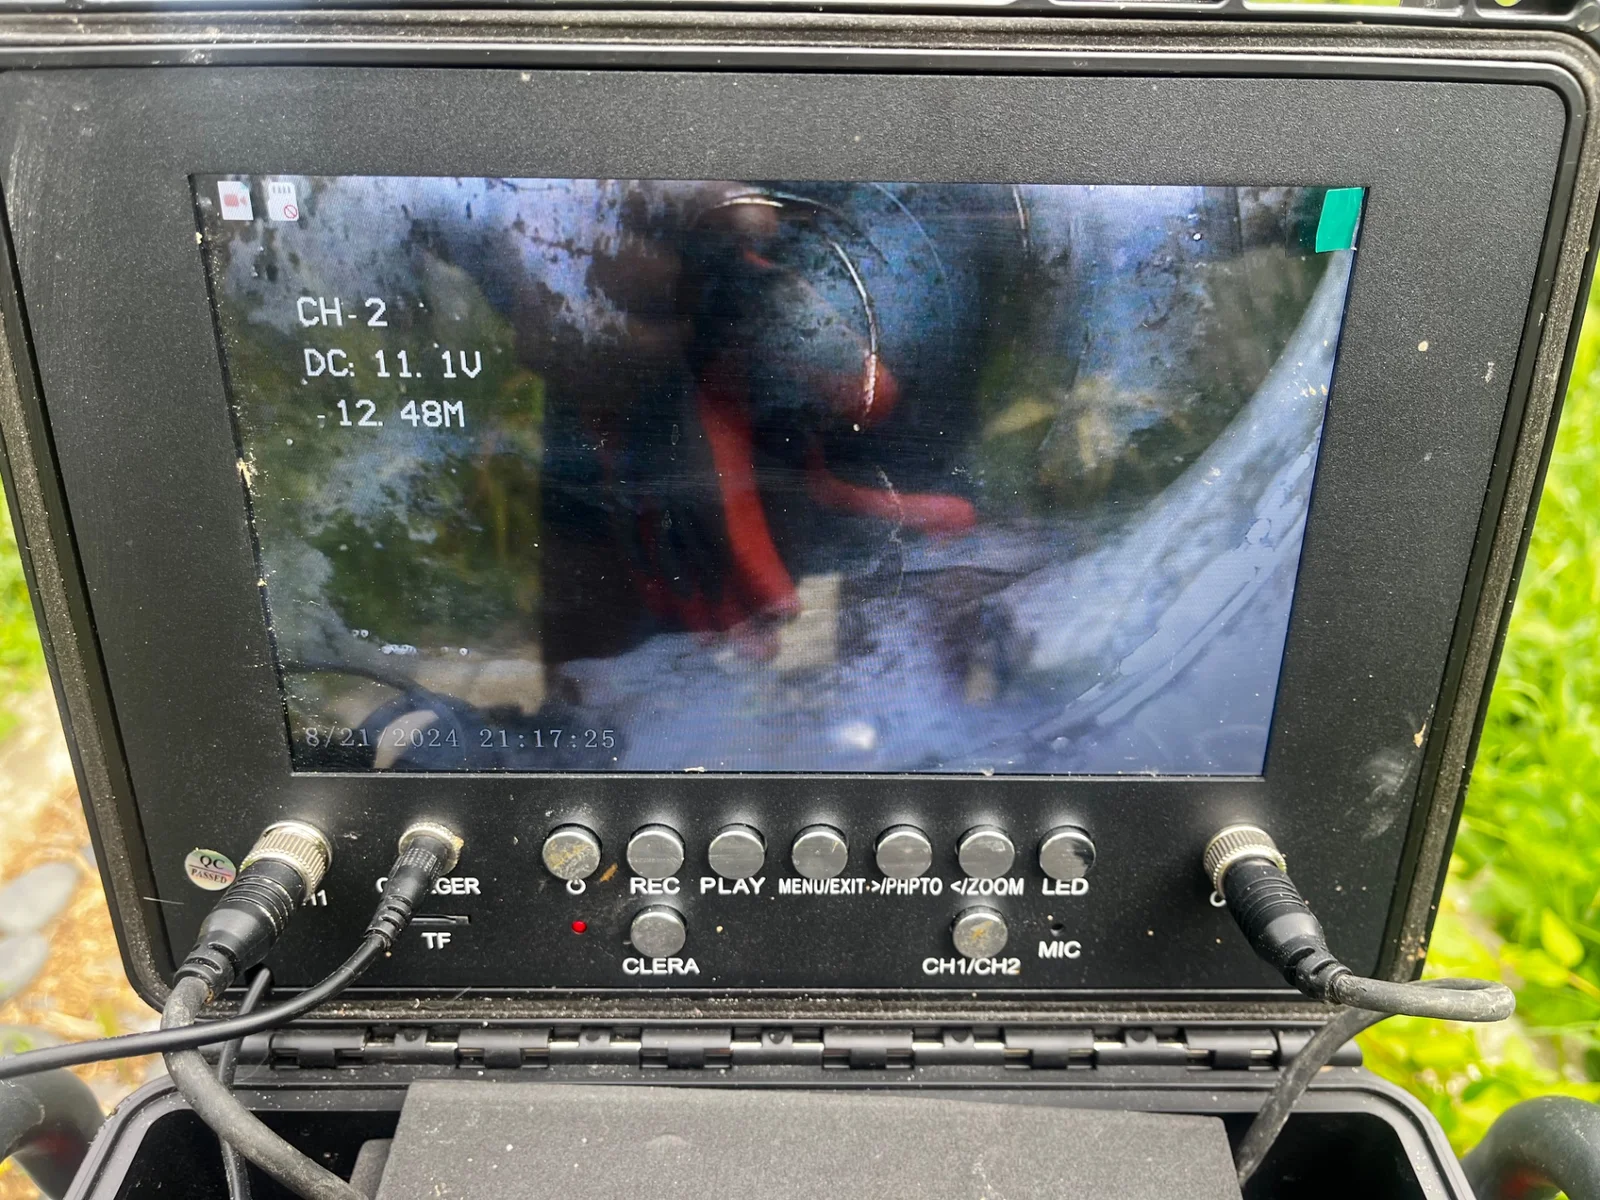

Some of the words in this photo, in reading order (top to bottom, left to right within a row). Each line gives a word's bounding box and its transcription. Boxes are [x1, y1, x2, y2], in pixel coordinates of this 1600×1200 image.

[305, 726, 460, 749] 8/21/2024
[480, 728, 616, 749] 21:17:25
[200, 855, 225, 870] QC
[191, 868, 228, 884] PASSED
[630, 877, 681, 895] REC
[700, 877, 766, 895] PLAY
[778, 877, 866, 895] MENU/EXIT
[1042, 877, 1089, 896] LED
[421, 932, 452, 950] TF
[1038, 940, 1082, 959] MIC
[622, 957, 700, 975] CLERA
[922, 957, 1021, 976] CH1/CH2
